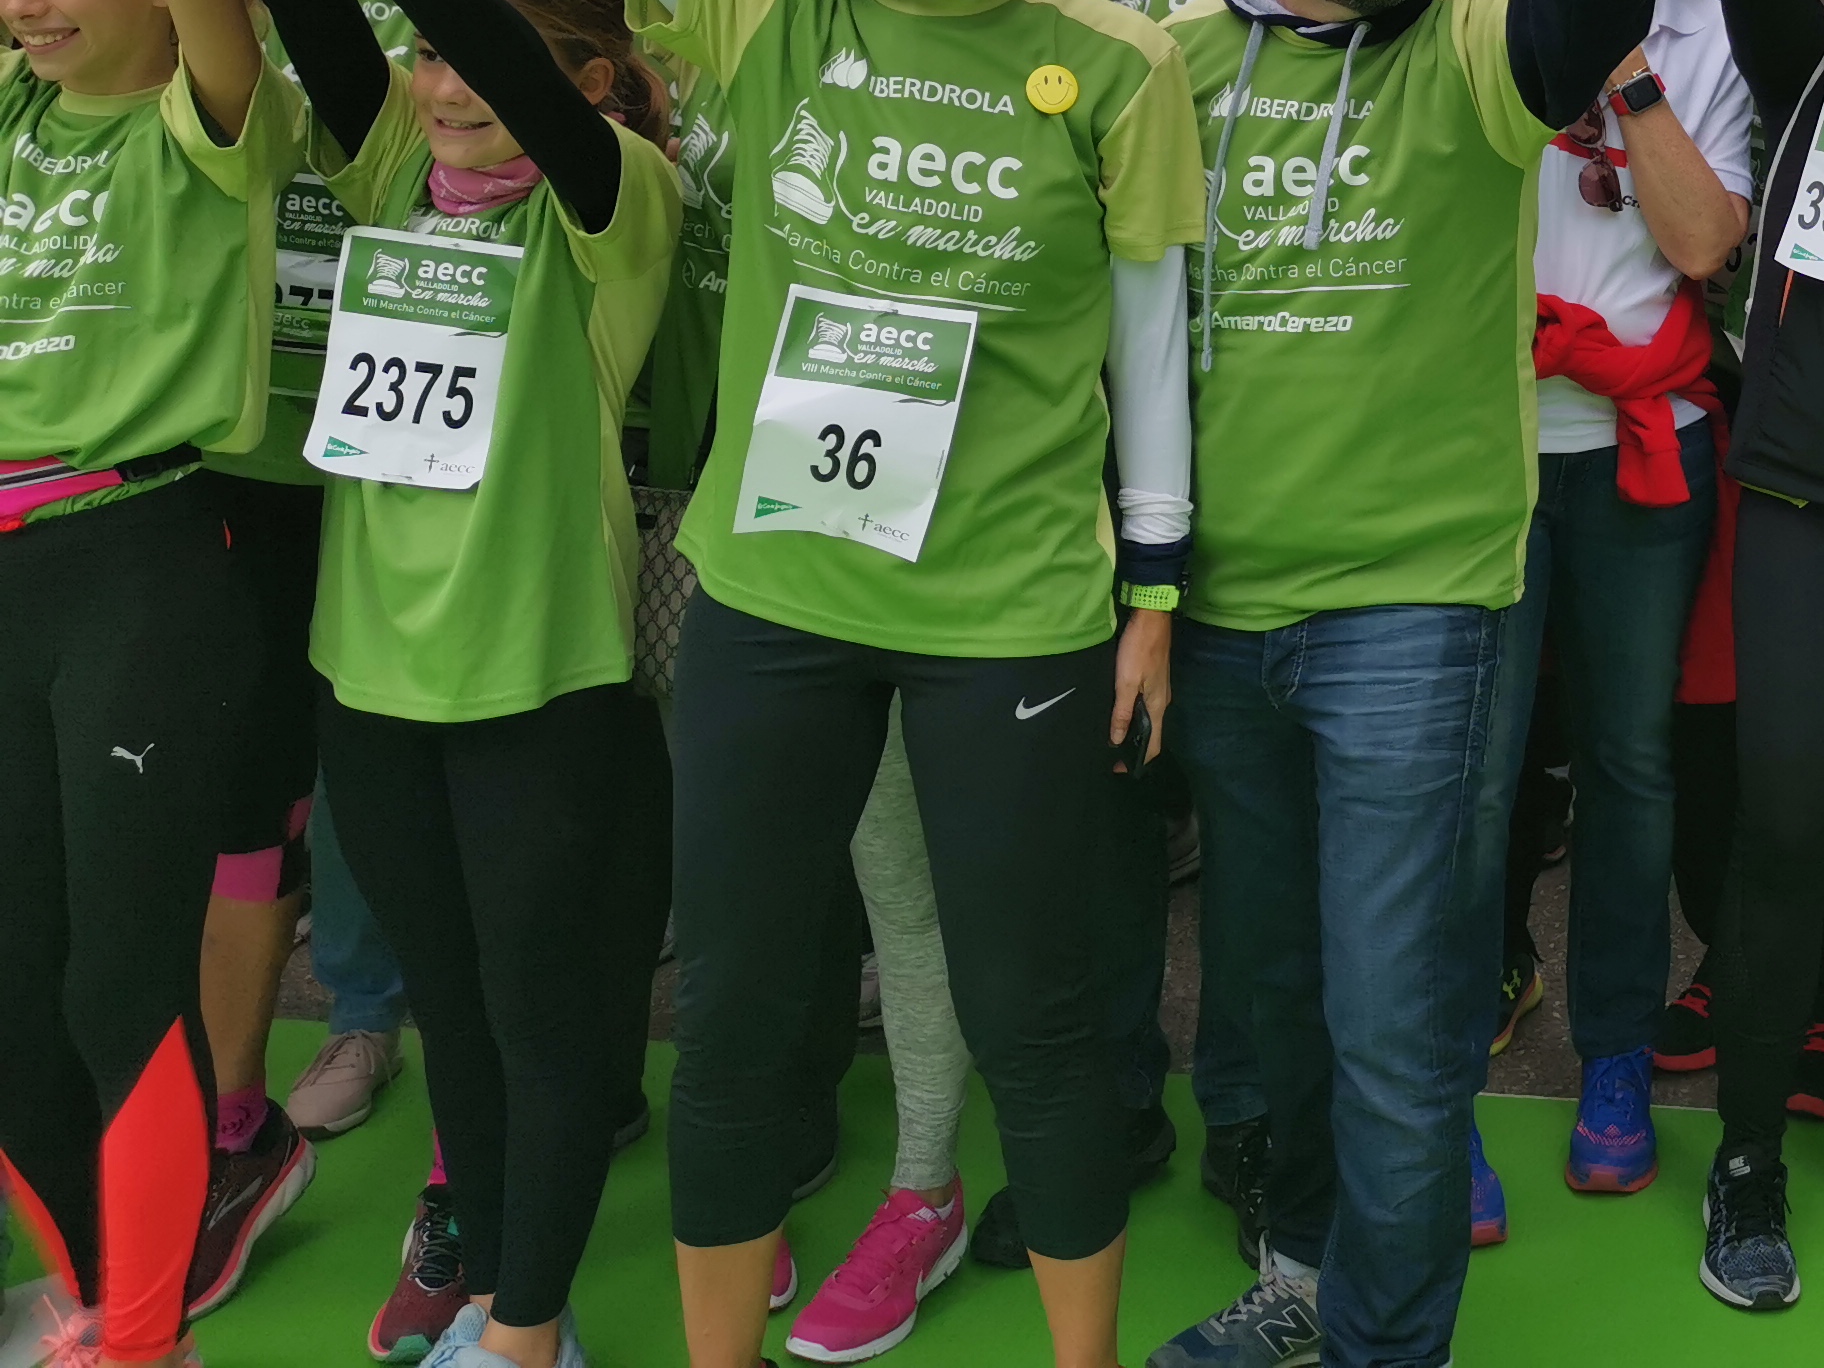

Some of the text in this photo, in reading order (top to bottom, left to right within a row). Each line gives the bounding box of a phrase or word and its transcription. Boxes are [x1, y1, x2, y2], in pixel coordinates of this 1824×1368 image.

[868, 75, 1016, 117] IBERDROLA
[867, 135, 1023, 199] aecc
[1242, 144, 1371, 198] aec
[286, 193, 344, 216] aecc
[864, 186, 983, 223] VALLADOLID
[0, 234, 91, 255] ALLADOLID
[851, 212, 1046, 262] en marcha
[417, 259, 488, 286] aecc
[848, 249, 923, 284] Contra
[930, 268, 950, 288] el
[957, 270, 1032, 297] Cáncer
[1305, 259, 1322, 277] el
[1329, 257, 1408, 277] Cáncer
[66, 280, 126, 298] áncer
[412, 287, 493, 308] en marcha
[415, 280, 459, 292] VALLADOLID
[362, 297, 497, 324] VIII Marcha Contra el Cáncer
[1211, 311, 1353, 333] AmaroCerezo
[857, 343, 903, 356] VALLADOLID
[859, 322, 934, 351] aecc
[854, 351, 940, 374] en marcha
[801, 362, 943, 391] VIII Marcha Contra el Cáncer
[341, 352, 477, 429] 2375
[440, 461, 475, 475] aecc
[810, 423, 882, 490] 36
[873, 522, 910, 542] aecc
